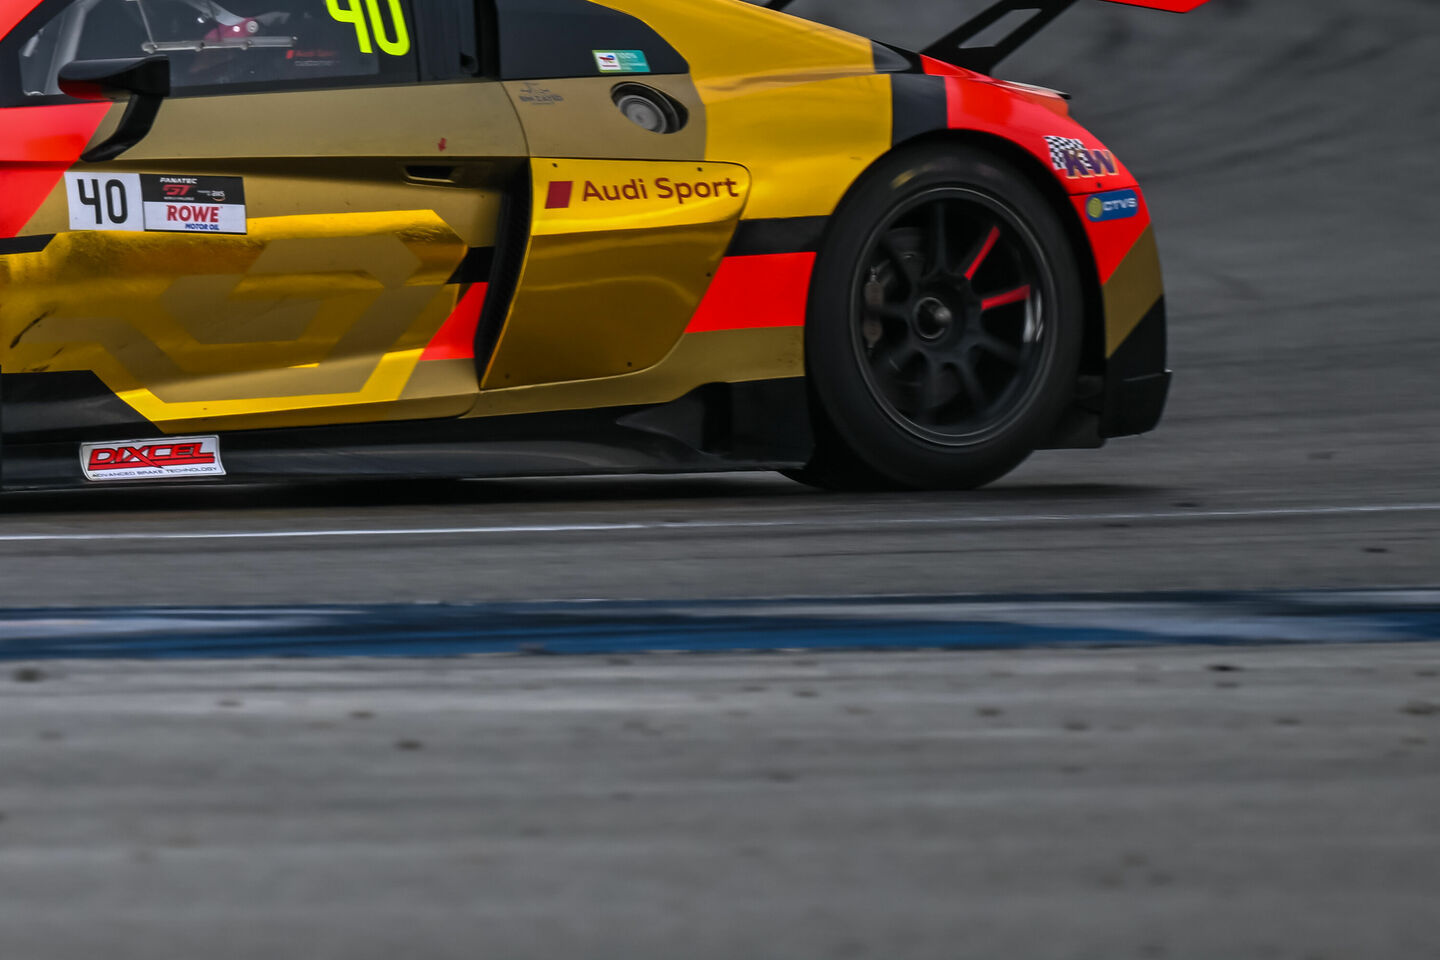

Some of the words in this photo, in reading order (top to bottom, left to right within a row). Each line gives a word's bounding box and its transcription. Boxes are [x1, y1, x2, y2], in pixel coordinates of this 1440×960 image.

[1061, 148, 1120, 179] KW
[76, 178, 129, 225] 40
[581, 178, 649, 202] Audi
[654, 176, 740, 205] Sport
[166, 204, 220, 223] ROWE
[1102, 197, 1138, 212] CTVS
[88, 442, 215, 468] DIXCEL
[166, 467, 218, 475] TECHNOLOGY
